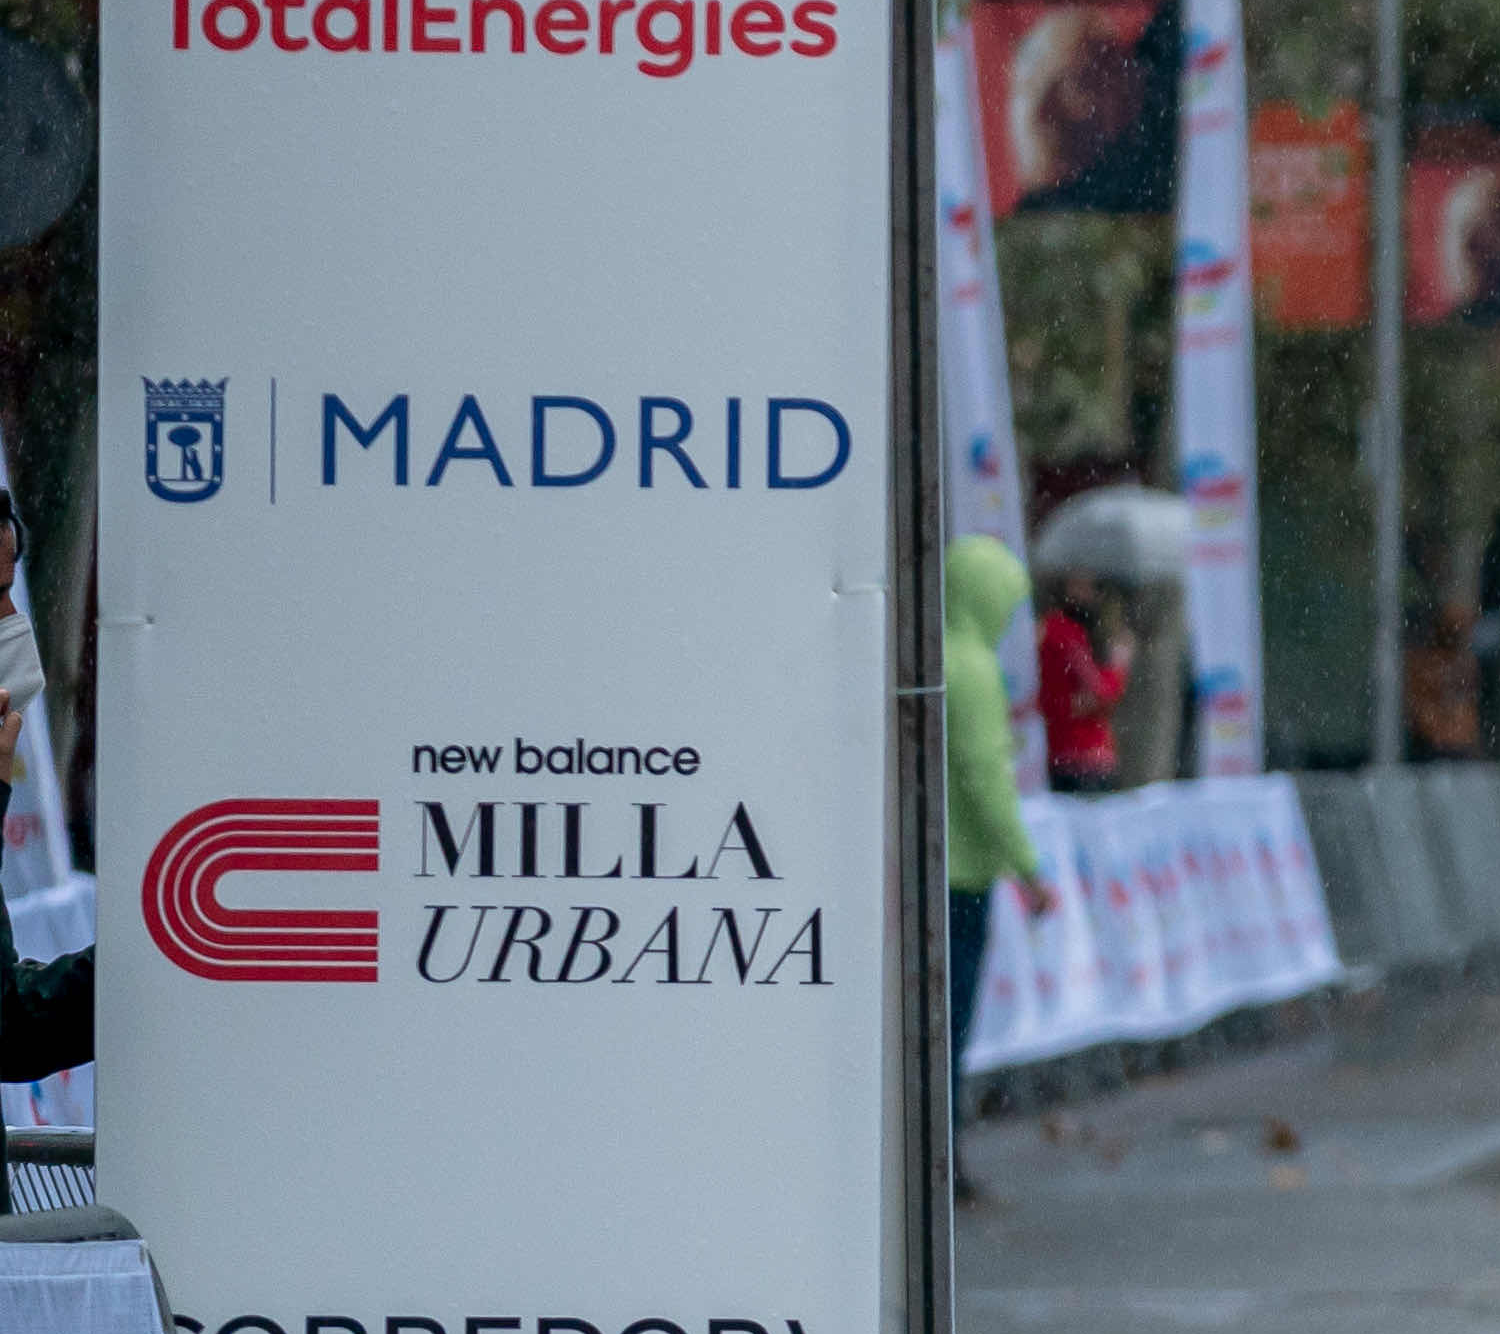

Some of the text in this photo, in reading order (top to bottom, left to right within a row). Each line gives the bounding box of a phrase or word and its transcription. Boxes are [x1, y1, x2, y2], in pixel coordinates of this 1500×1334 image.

[321, 393, 852, 490] MADRID
[412, 737, 701, 776] new balance
[413, 801, 784, 880] MILLA
[416, 905, 834, 985] URBANA
